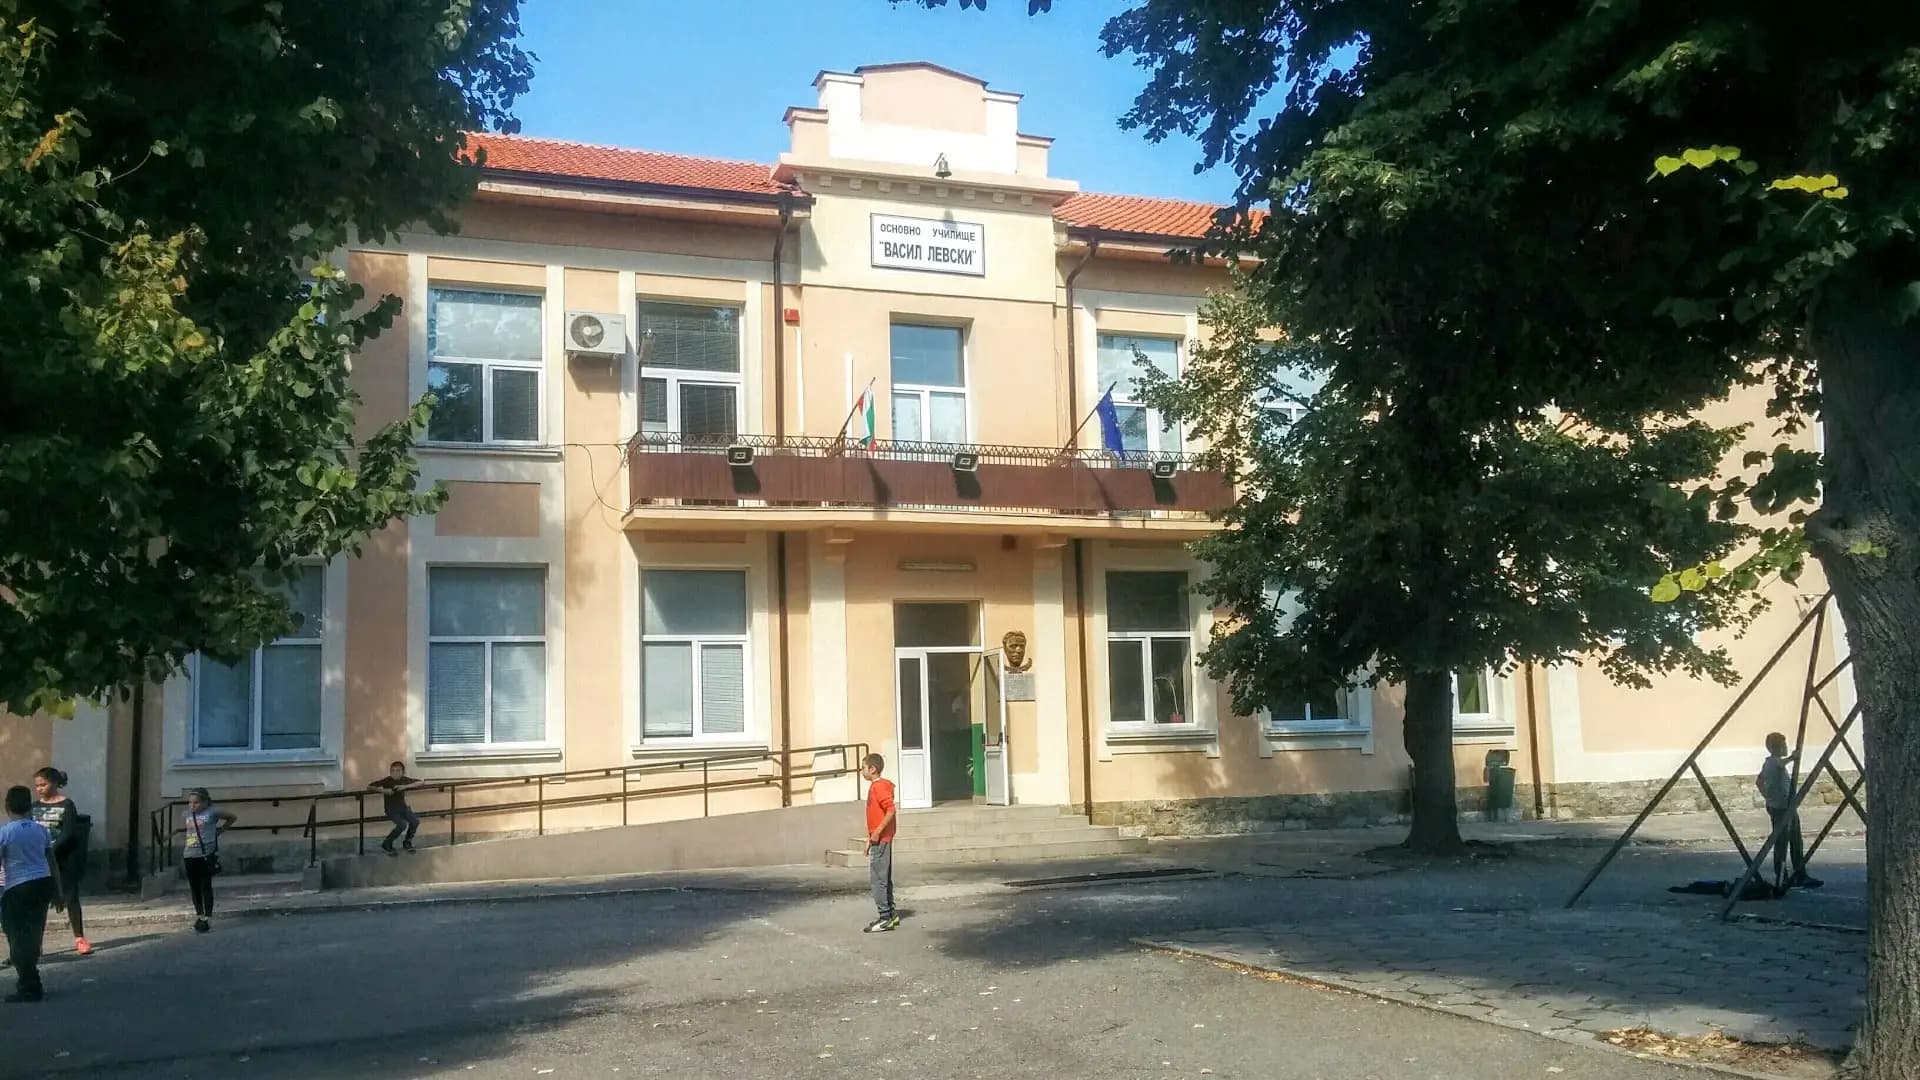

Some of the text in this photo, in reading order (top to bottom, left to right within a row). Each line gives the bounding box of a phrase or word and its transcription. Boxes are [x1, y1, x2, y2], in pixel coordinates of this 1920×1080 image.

[880, 223, 976, 242] ОСНОВНО УЧИЛИЩЕ
[879, 241, 977, 265] "ВАСИЛ ЛЕВСКИ"
